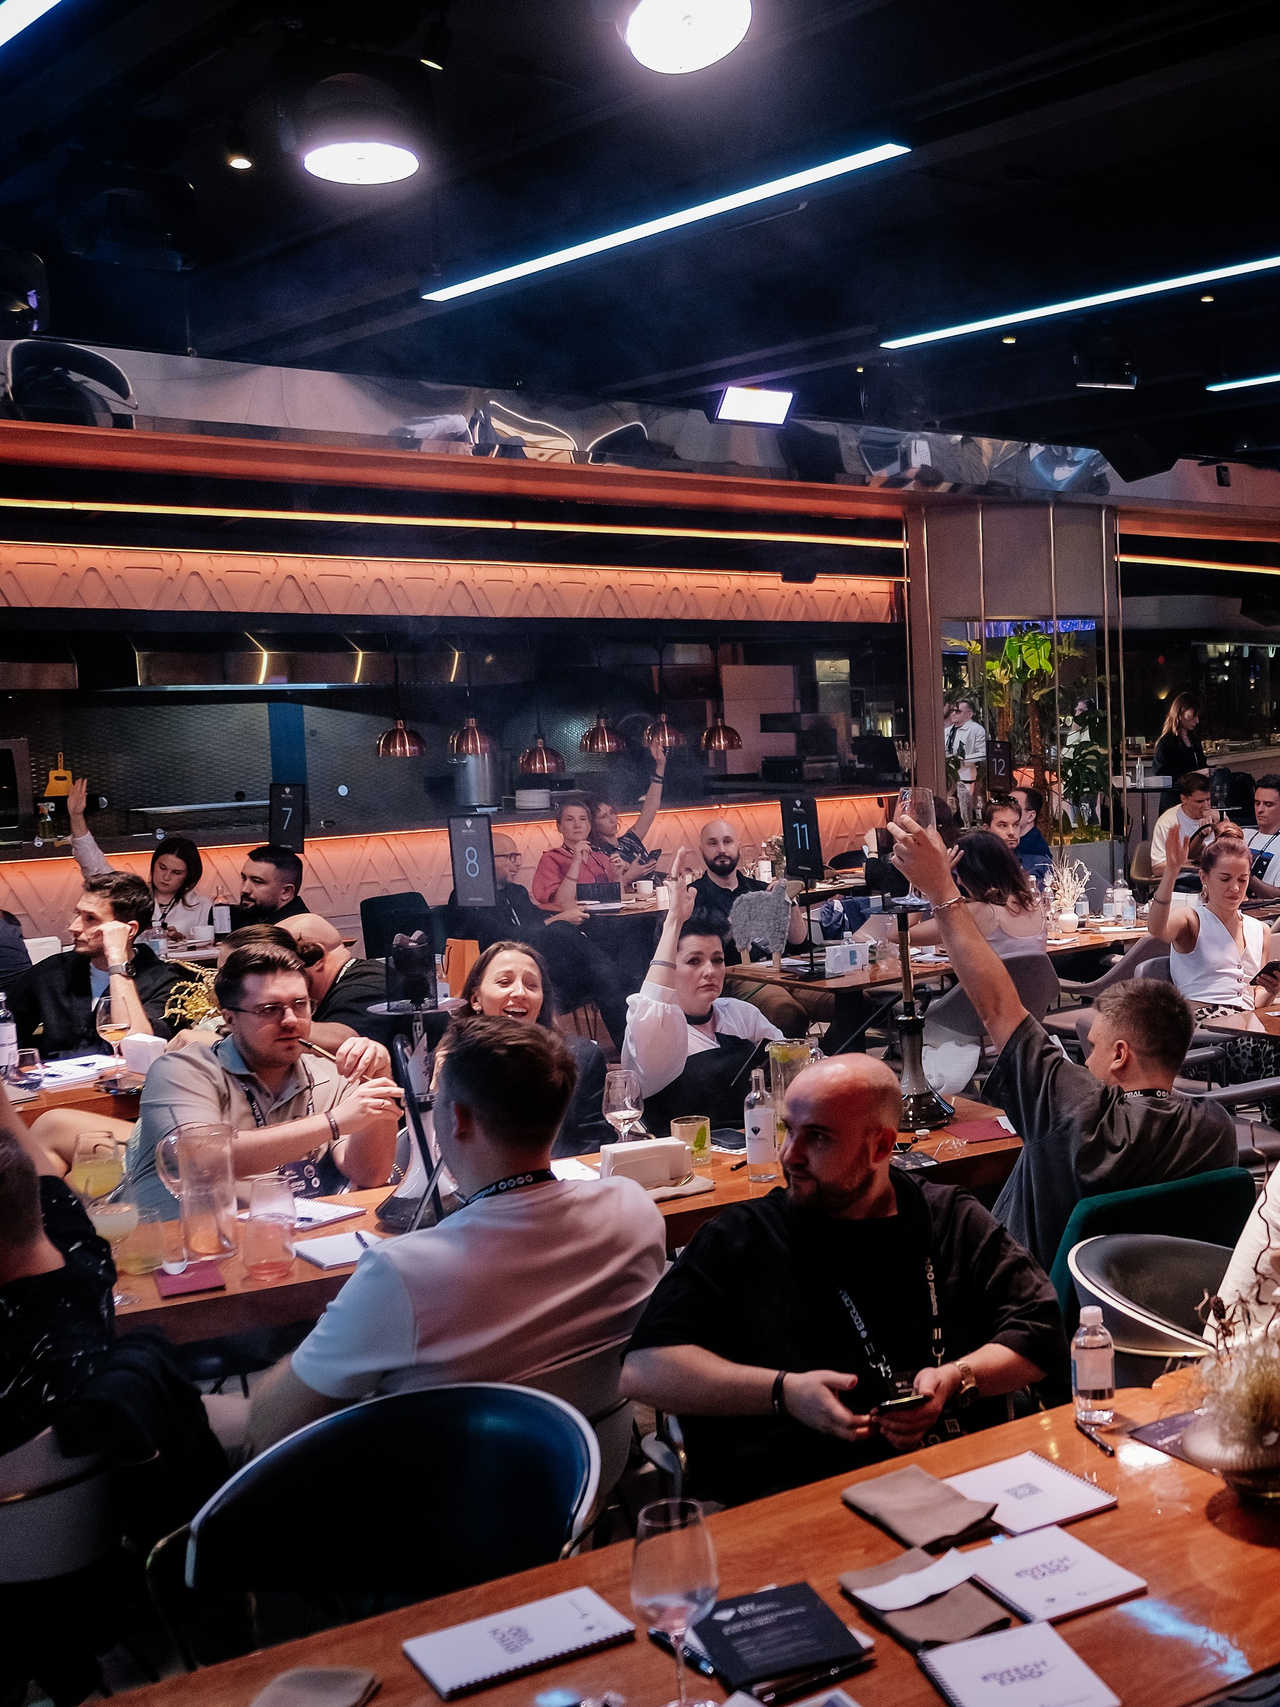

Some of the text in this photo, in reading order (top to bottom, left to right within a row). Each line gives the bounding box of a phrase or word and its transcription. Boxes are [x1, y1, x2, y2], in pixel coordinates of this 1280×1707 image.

[992, 758, 1006, 776] 12
[282, 807, 293, 830] 7
[792, 822, 810, 850] 11
[465, 846, 480, 878] 8
